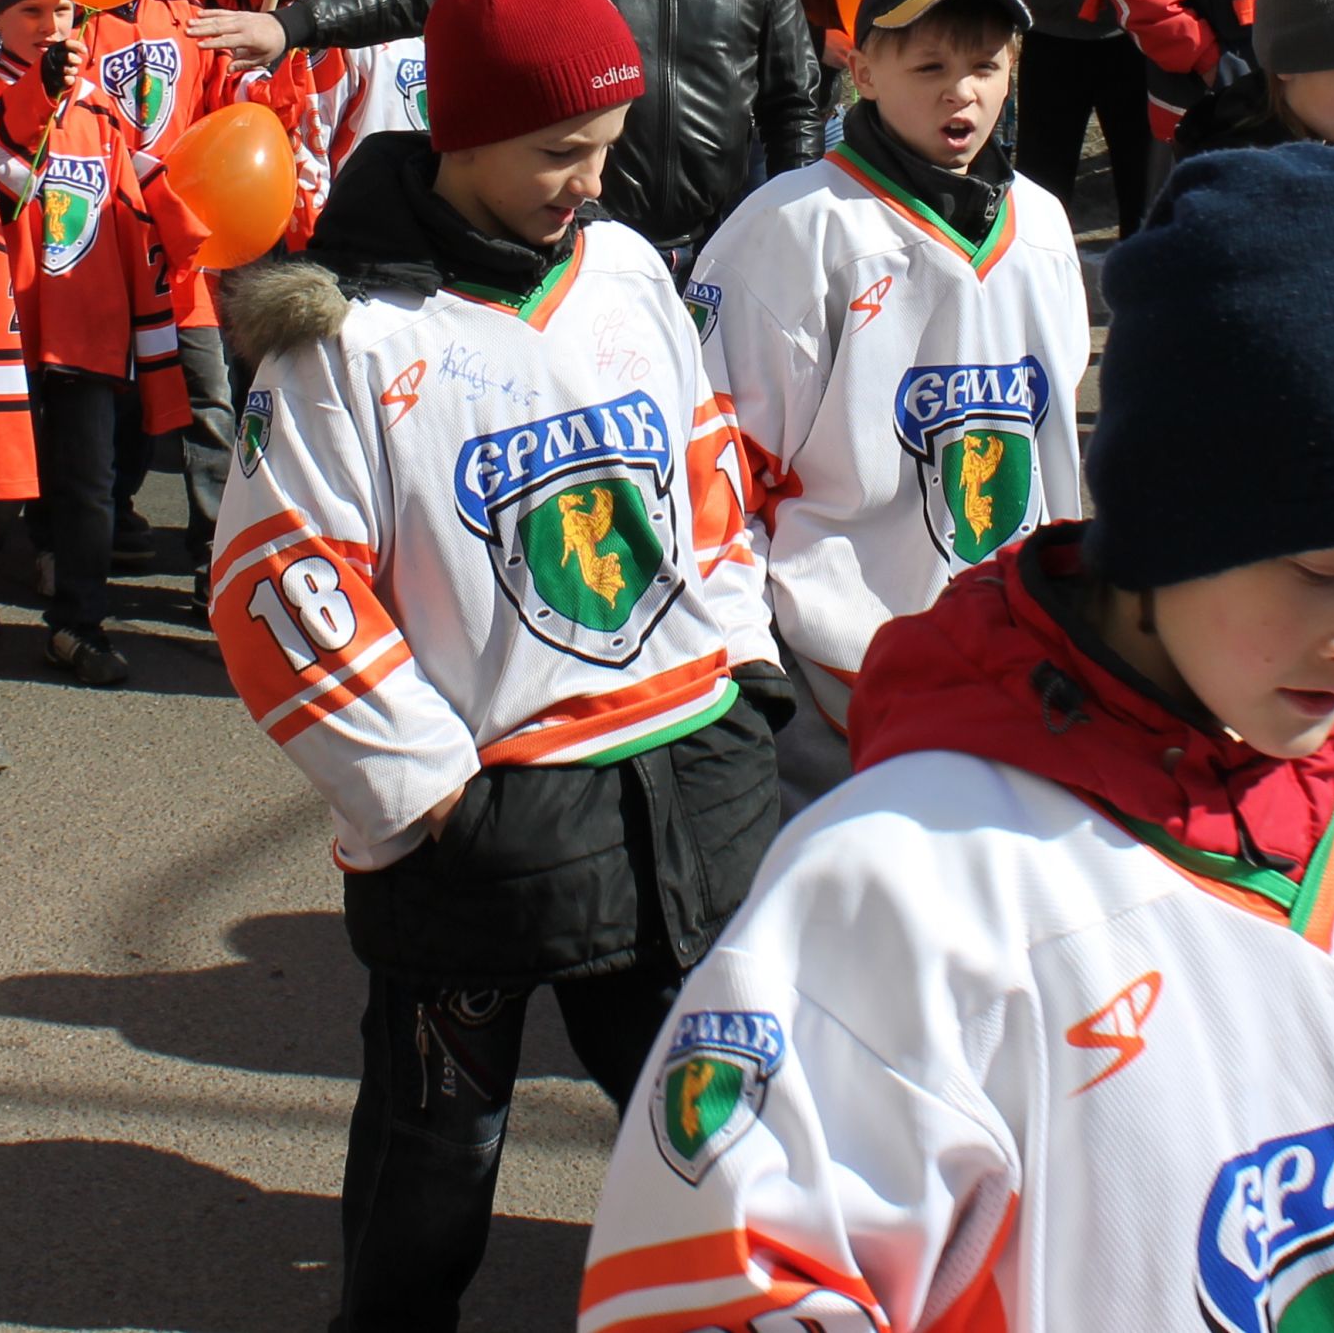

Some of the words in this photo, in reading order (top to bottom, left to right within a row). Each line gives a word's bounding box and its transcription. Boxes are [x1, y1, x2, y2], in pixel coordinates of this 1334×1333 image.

[591, 63, 641, 89] adidas
[49, 157, 104, 190] МАК
[463, 400, 666, 498] ЕРМАК
[247, 555, 357, 675] 18
[672, 1013, 781, 1057] РМАК
